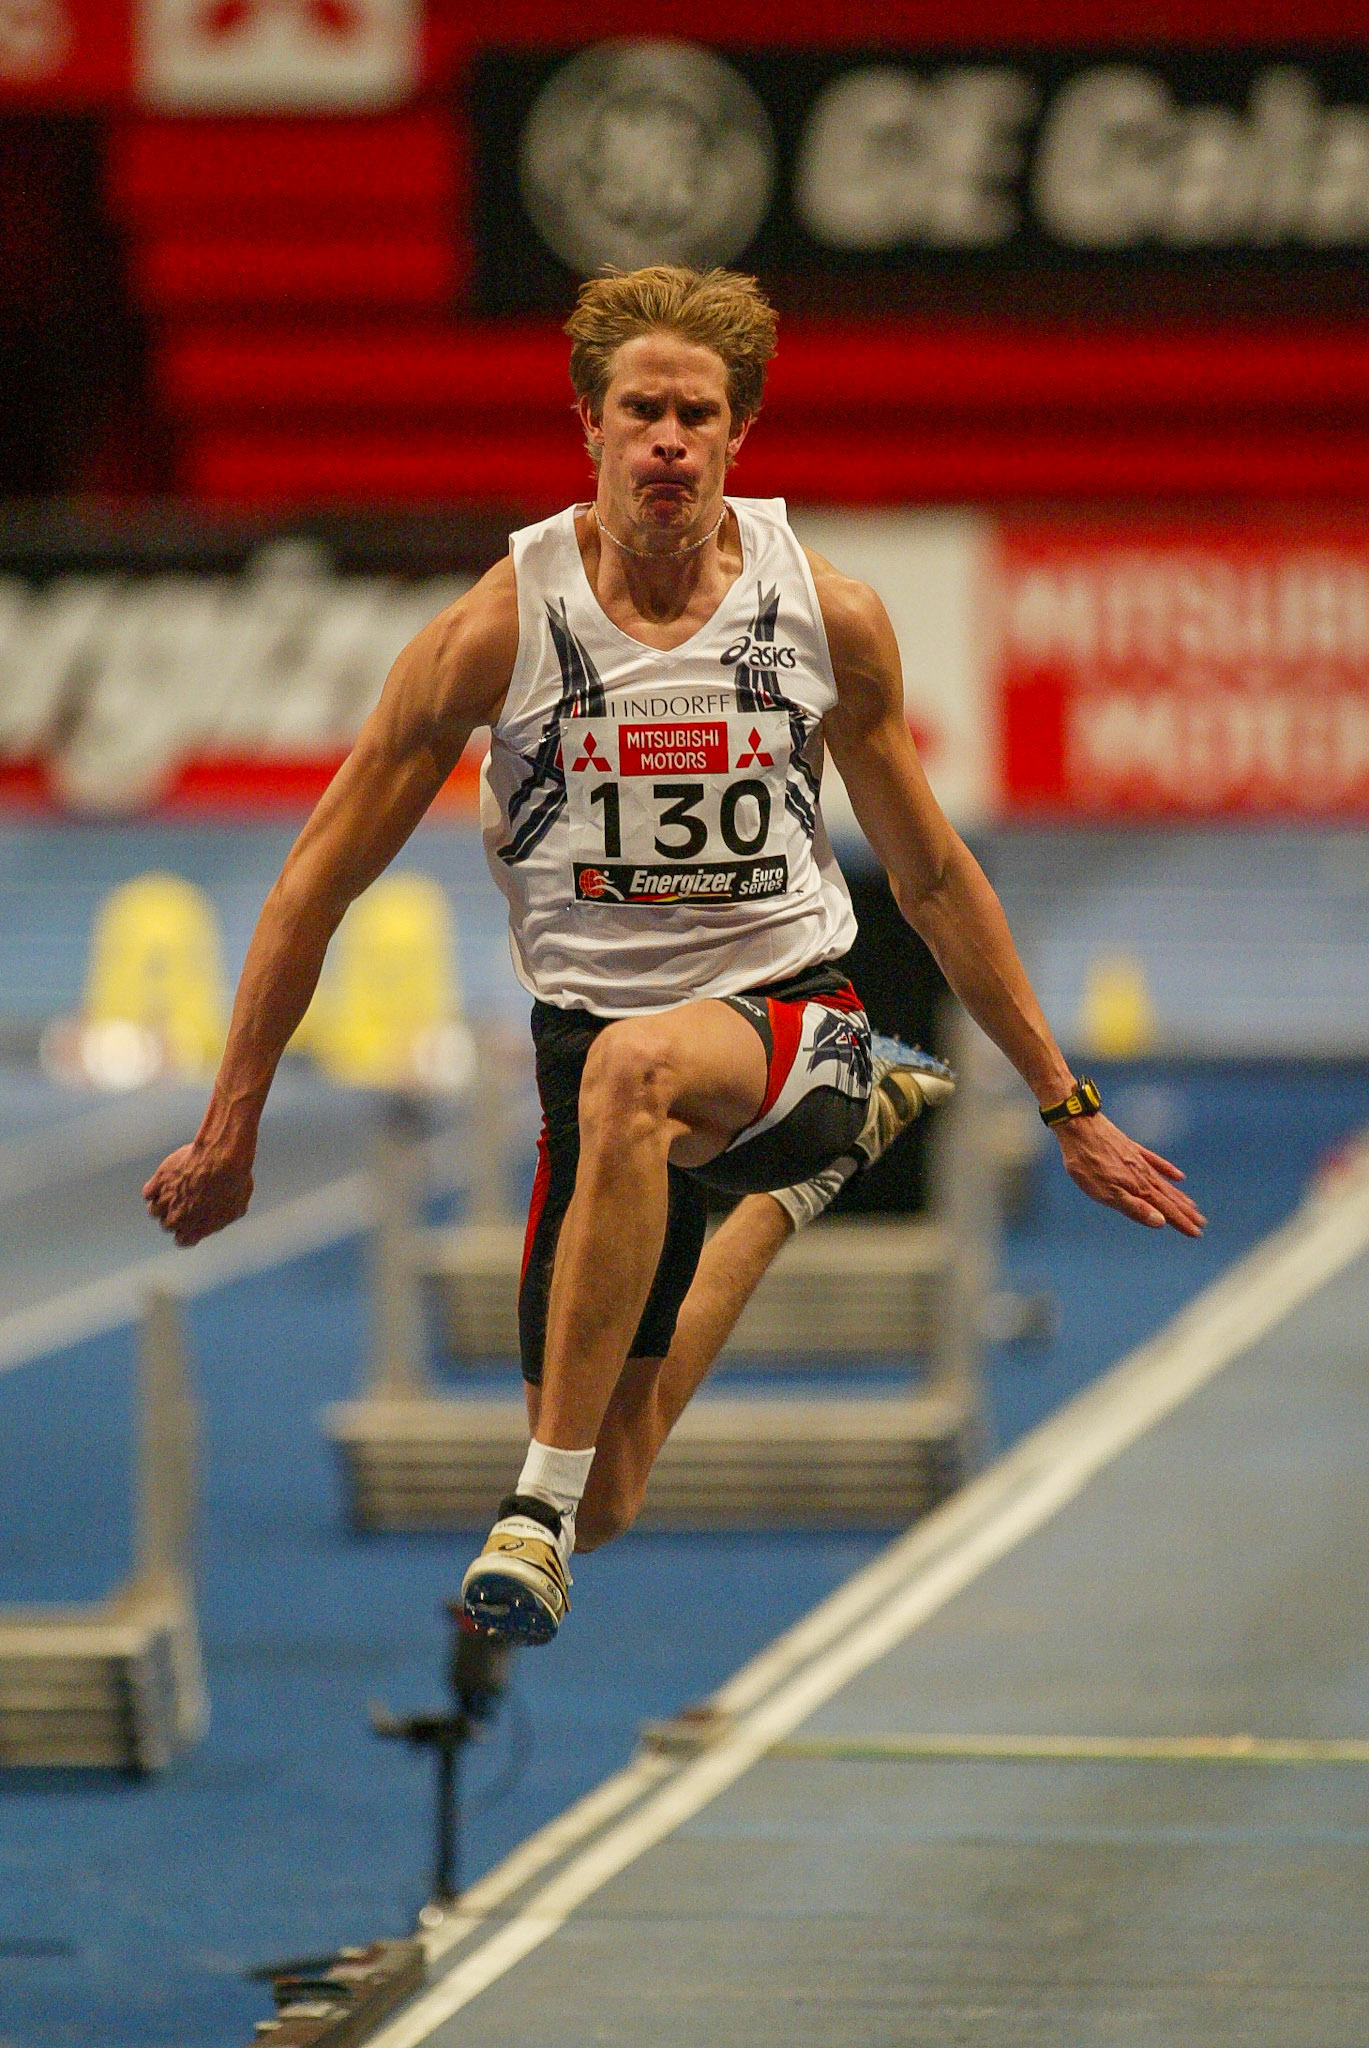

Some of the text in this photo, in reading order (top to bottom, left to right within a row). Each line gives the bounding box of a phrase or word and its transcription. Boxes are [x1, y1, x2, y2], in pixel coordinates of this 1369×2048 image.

[626, 729, 719, 749] MITSUBISHI
[640, 751, 707, 770] MOTORS
[590, 779, 771, 860] 130
[629, 868, 737, 897] Energizer
[751, 867, 784, 883] Euro
